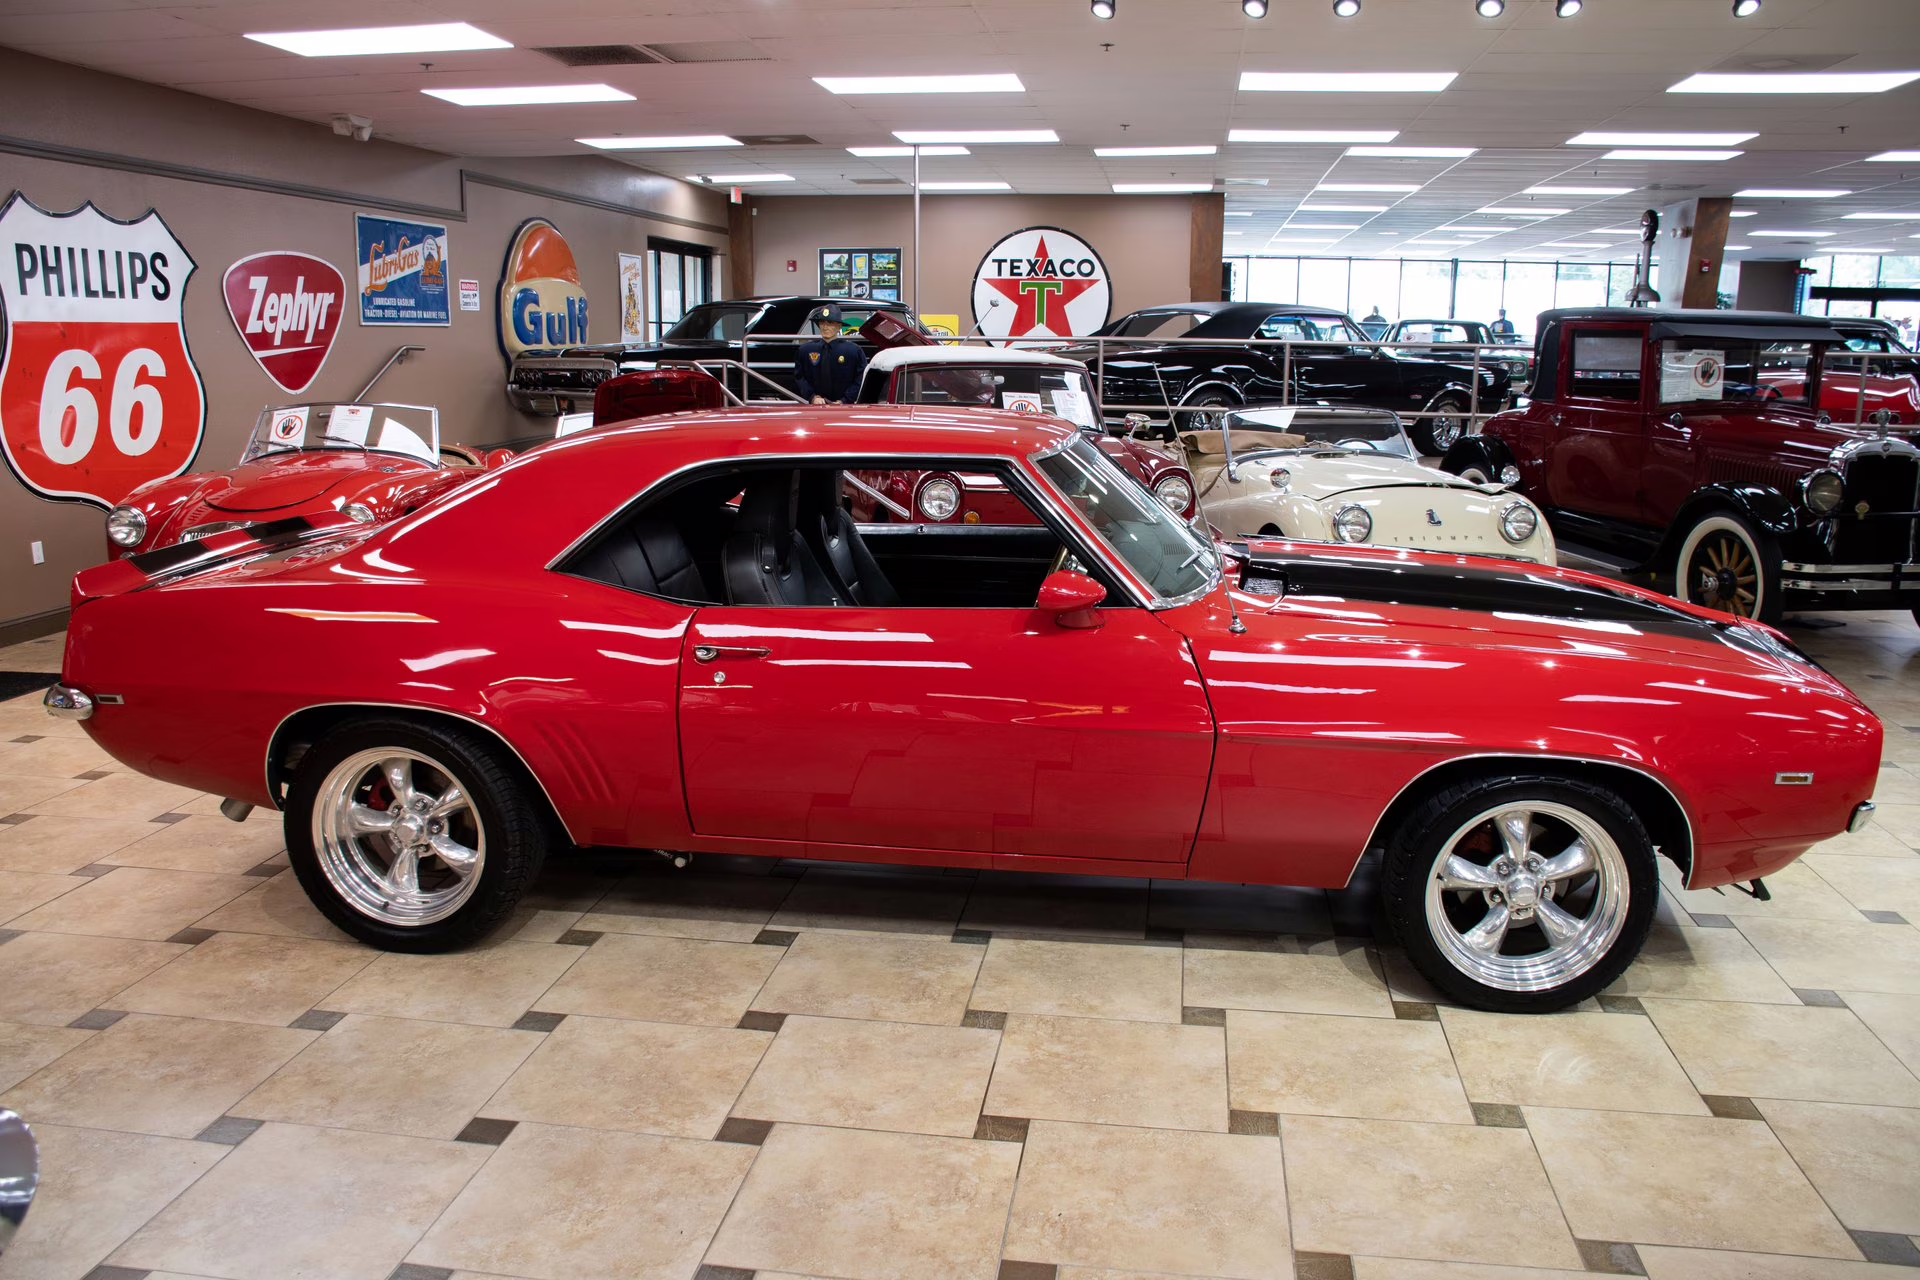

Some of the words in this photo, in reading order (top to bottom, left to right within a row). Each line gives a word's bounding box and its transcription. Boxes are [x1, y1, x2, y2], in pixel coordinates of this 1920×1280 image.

[15, 242, 171, 301] PHILLIPS
[461, 283, 477, 291] WARNING
[992, 258, 1096, 278] TEXACO
[245, 276, 335, 346] Zephyr
[373, 297, 397, 306] LUBRICATED
[397, 298, 416, 307] GASOLINE
[417, 310, 423, 319] OR
[423, 311, 438, 319] MARINE
[512, 288, 588, 346] Gulf
[38, 348, 167, 465] 66
